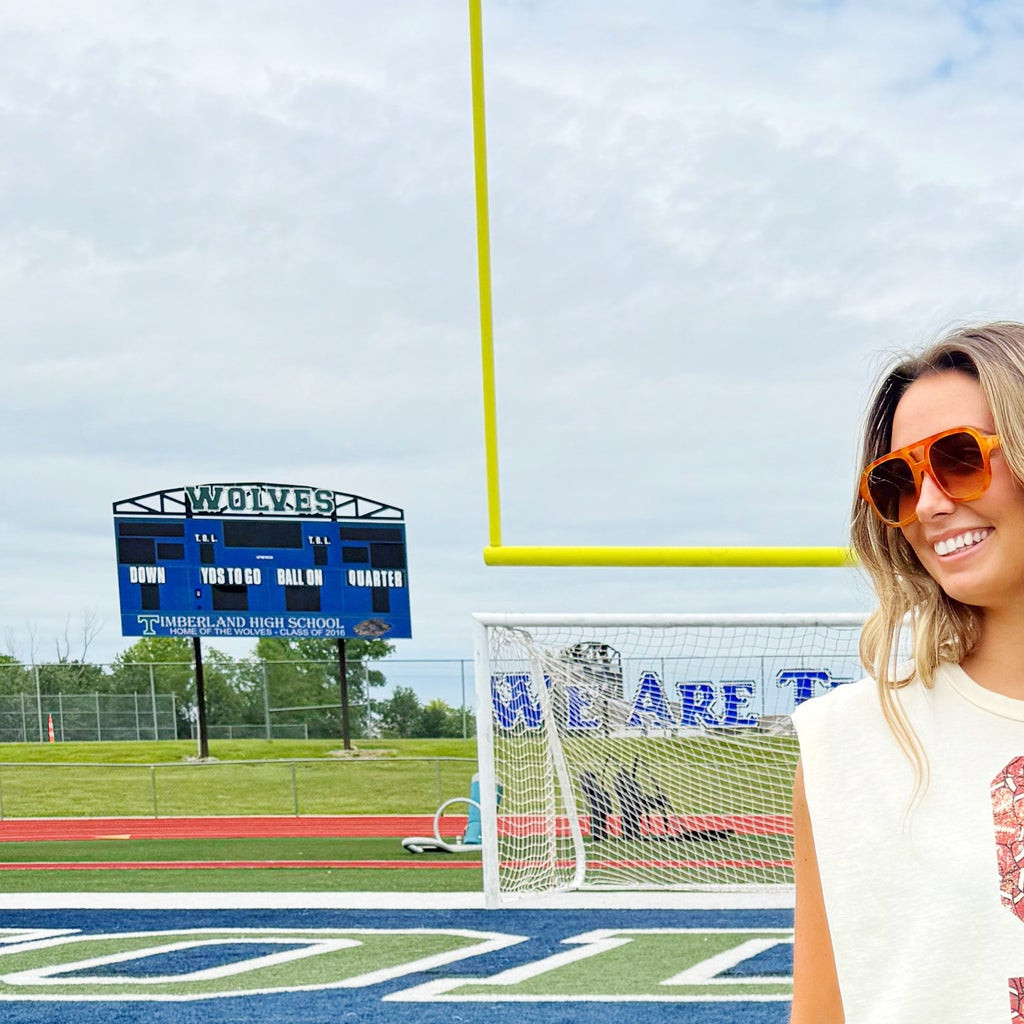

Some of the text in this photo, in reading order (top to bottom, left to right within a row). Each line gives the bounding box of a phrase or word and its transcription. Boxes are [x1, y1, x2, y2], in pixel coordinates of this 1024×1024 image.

[185, 485, 335, 515] WOLVES
[129, 566, 166, 584] DOWN
[201, 567, 262, 585] YDS TO GO
[277, 568, 323, 586] BALL ON
[348, 569, 403, 587] QUARTER
[137, 614, 345, 635] TIMBERLAND HIGH SCHOOL
[234, 628, 272, 636] WOLVES
[279, 628, 309, 636] CLASS
[489, 672, 602, 729] WE
[626, 669, 760, 728] ARE
